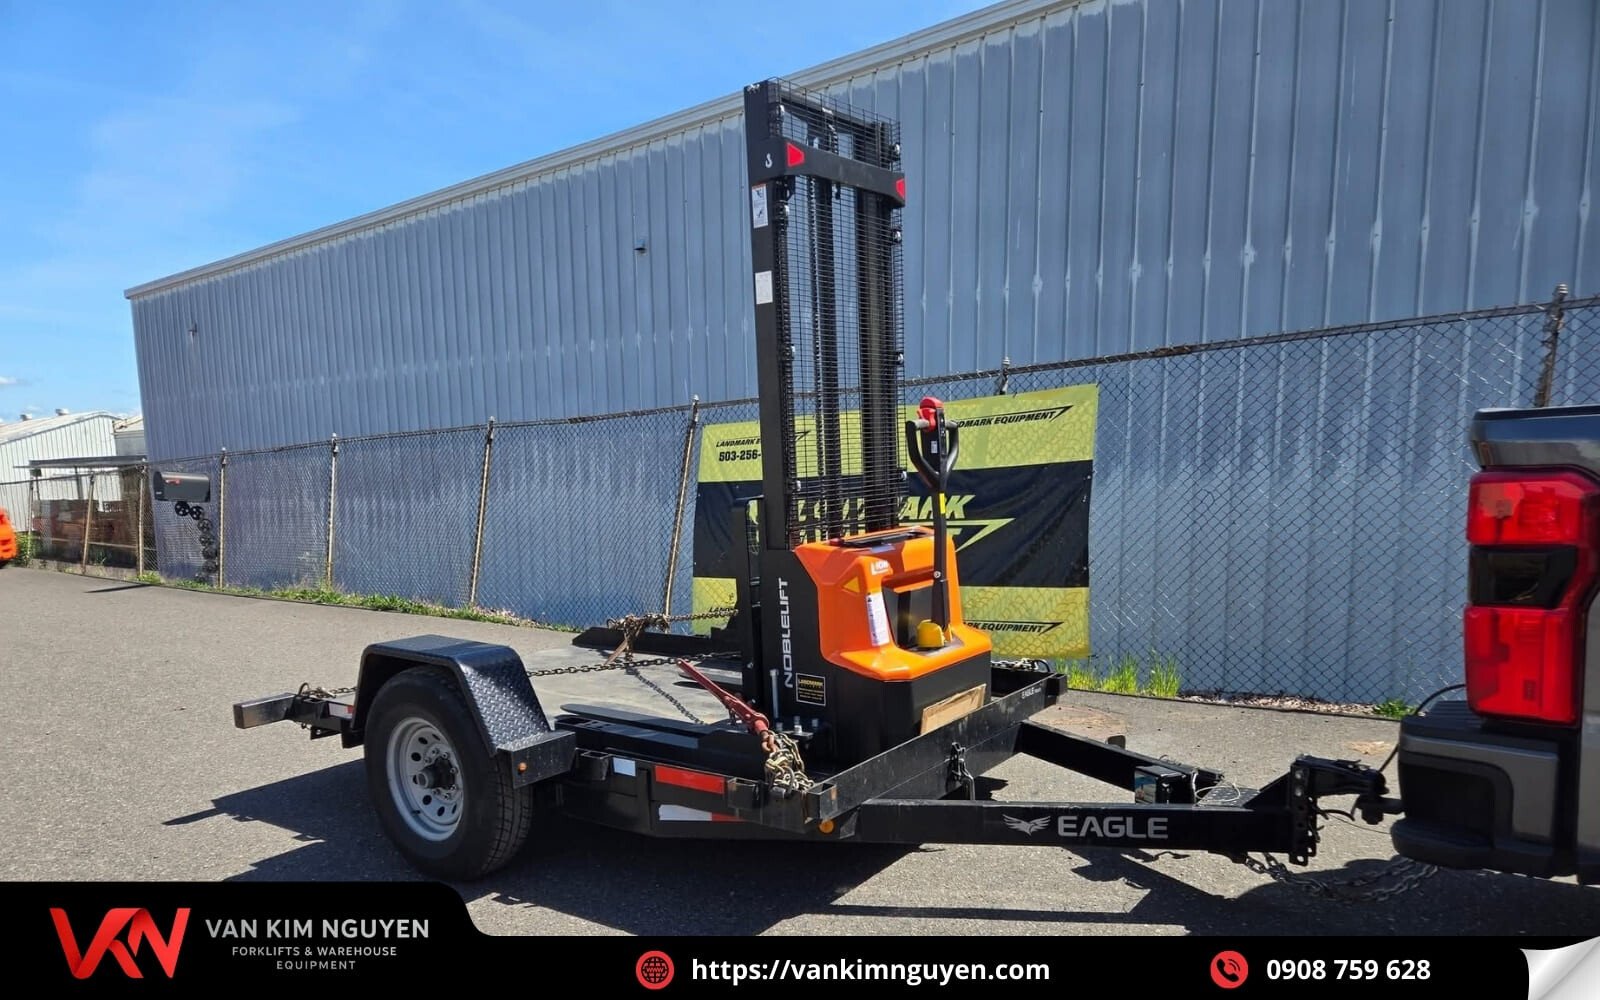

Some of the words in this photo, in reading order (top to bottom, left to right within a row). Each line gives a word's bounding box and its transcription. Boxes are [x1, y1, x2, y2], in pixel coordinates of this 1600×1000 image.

[957, 417, 994, 428] DMARK
[994, 411, 1056, 425] EQUIPMENT
[716, 439, 755, 448] LANDMARK
[719, 449, 761, 462] 503-256-
[779, 577, 793, 688] NOBLELIFT
[980, 622, 1046, 633] EQUIPMENT
[1057, 815, 1169, 839] EAGLE
